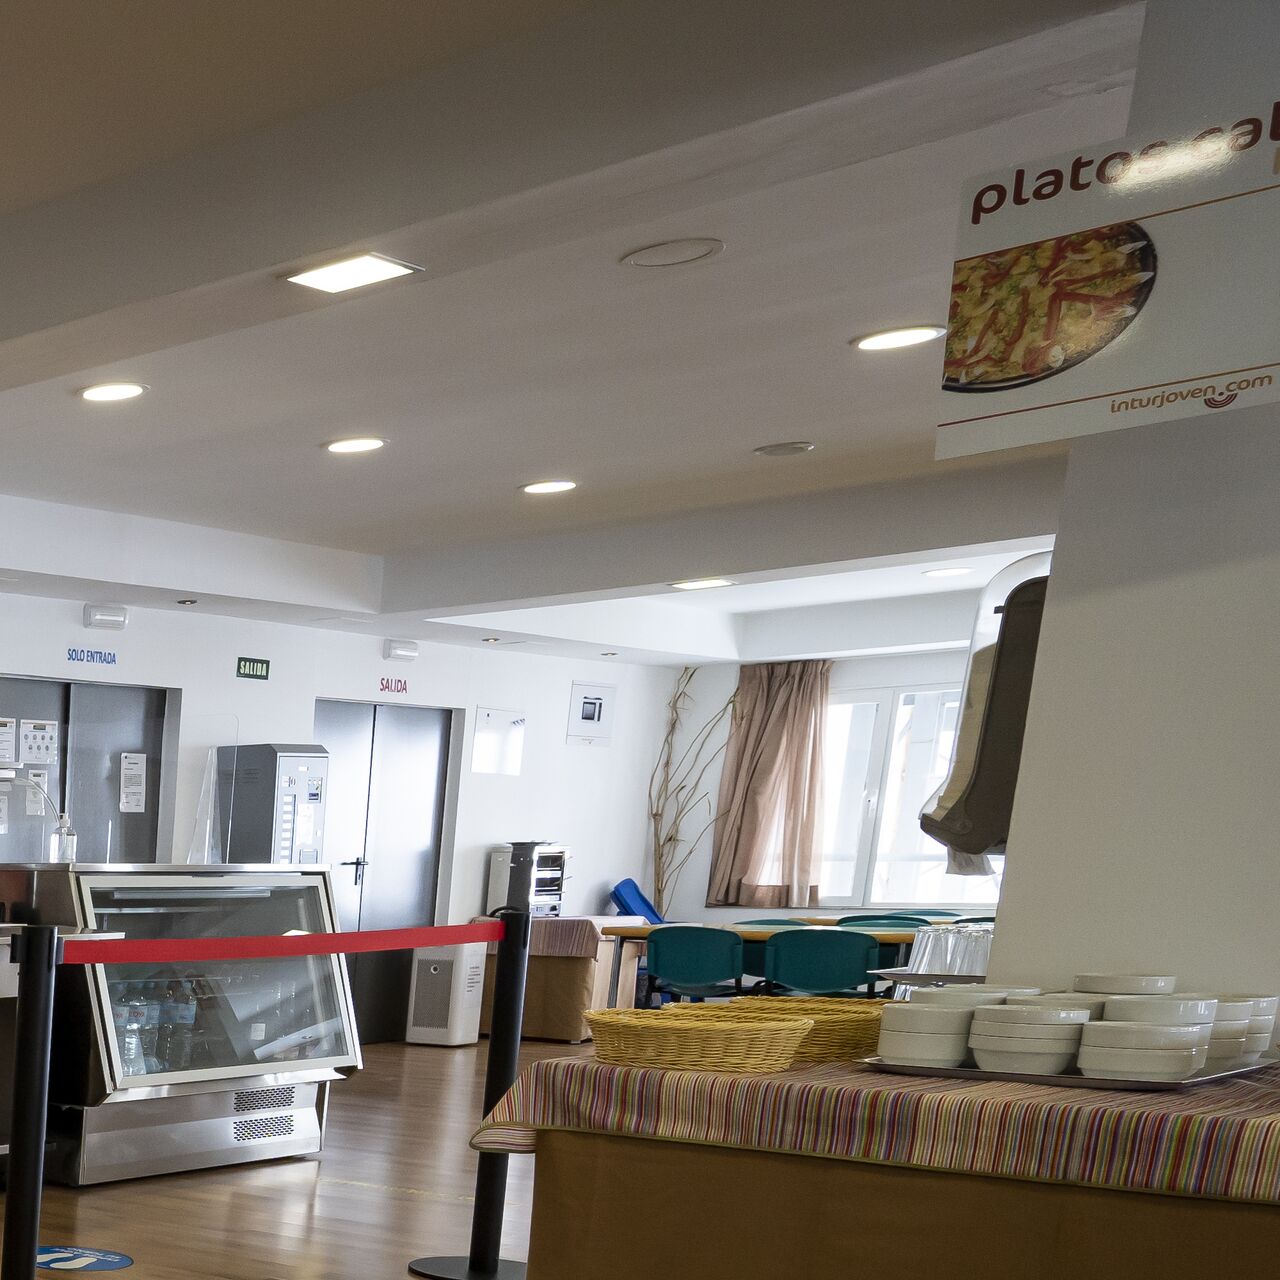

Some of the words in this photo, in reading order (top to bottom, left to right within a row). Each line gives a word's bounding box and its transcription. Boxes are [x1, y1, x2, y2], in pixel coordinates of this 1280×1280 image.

[1110, 373, 1273, 414] inturjoven.com
[67, 648, 85, 662] SOLO
[86, 650, 117, 665] ENTRADA
[240, 661, 267, 676] SALIDA
[379, 677, 408, 693] SALIDA
